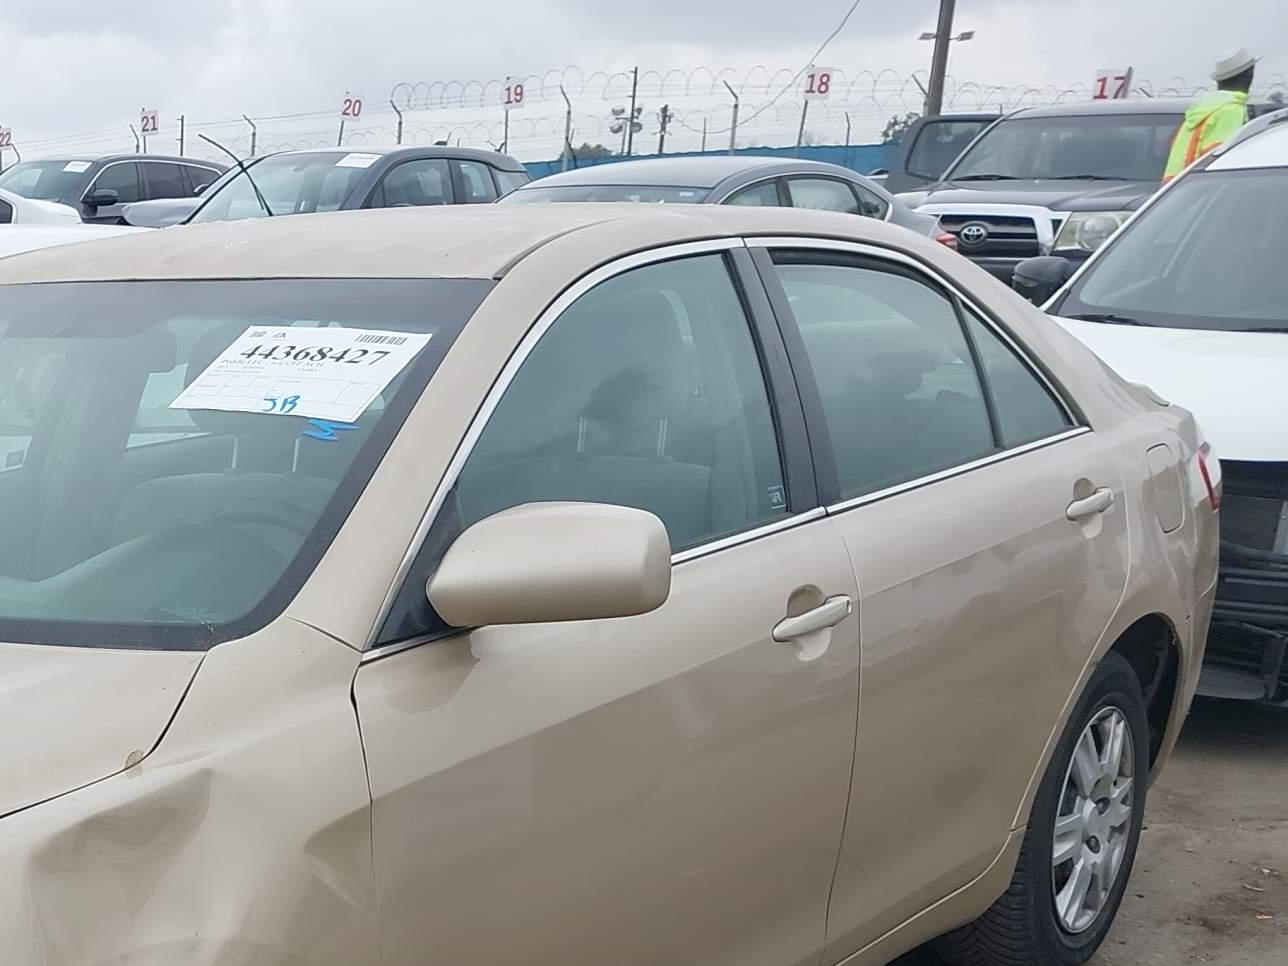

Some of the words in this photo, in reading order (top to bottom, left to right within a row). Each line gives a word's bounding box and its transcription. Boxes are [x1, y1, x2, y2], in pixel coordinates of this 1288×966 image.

[805, 73, 830, 94] 18
[1093, 76, 1128, 99] 17
[504, 84, 523, 104] 19
[343, 98, 361, 116] 20
[141, 115, 157, 131] 21
[240, 344, 391, 365] 44368427
